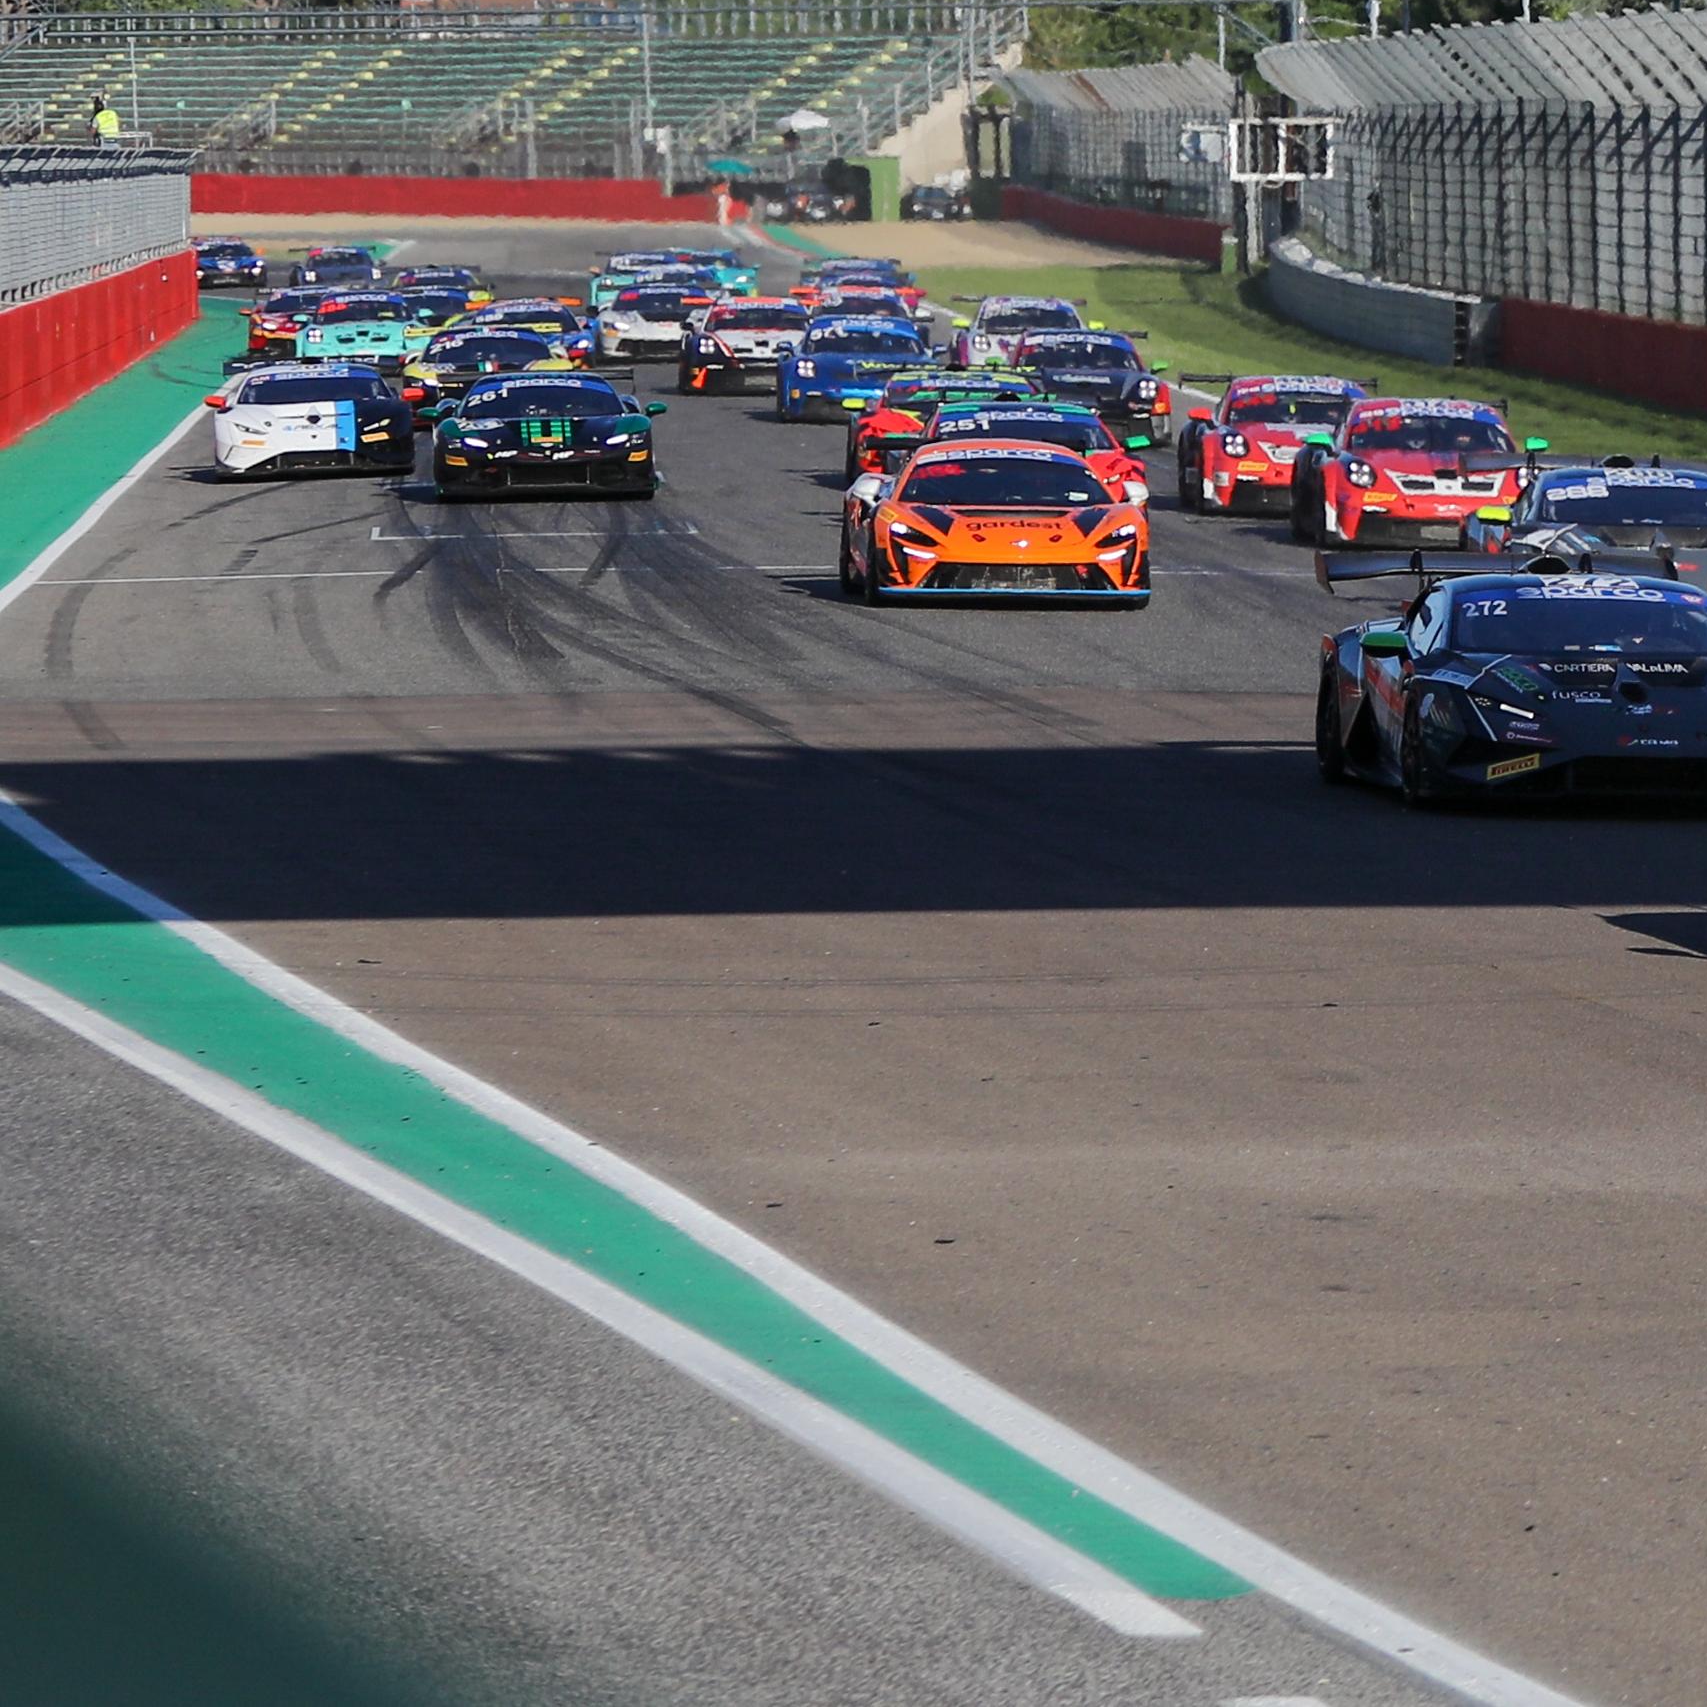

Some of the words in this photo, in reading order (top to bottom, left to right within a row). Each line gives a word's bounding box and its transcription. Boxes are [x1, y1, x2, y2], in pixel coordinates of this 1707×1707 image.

[467, 388, 510, 408] 261
[939, 420, 991, 433] 251
[965, 519, 1064, 532] gardest
[1462, 599, 1509, 618] 272
[1554, 663, 1616, 674] CARTIERA
